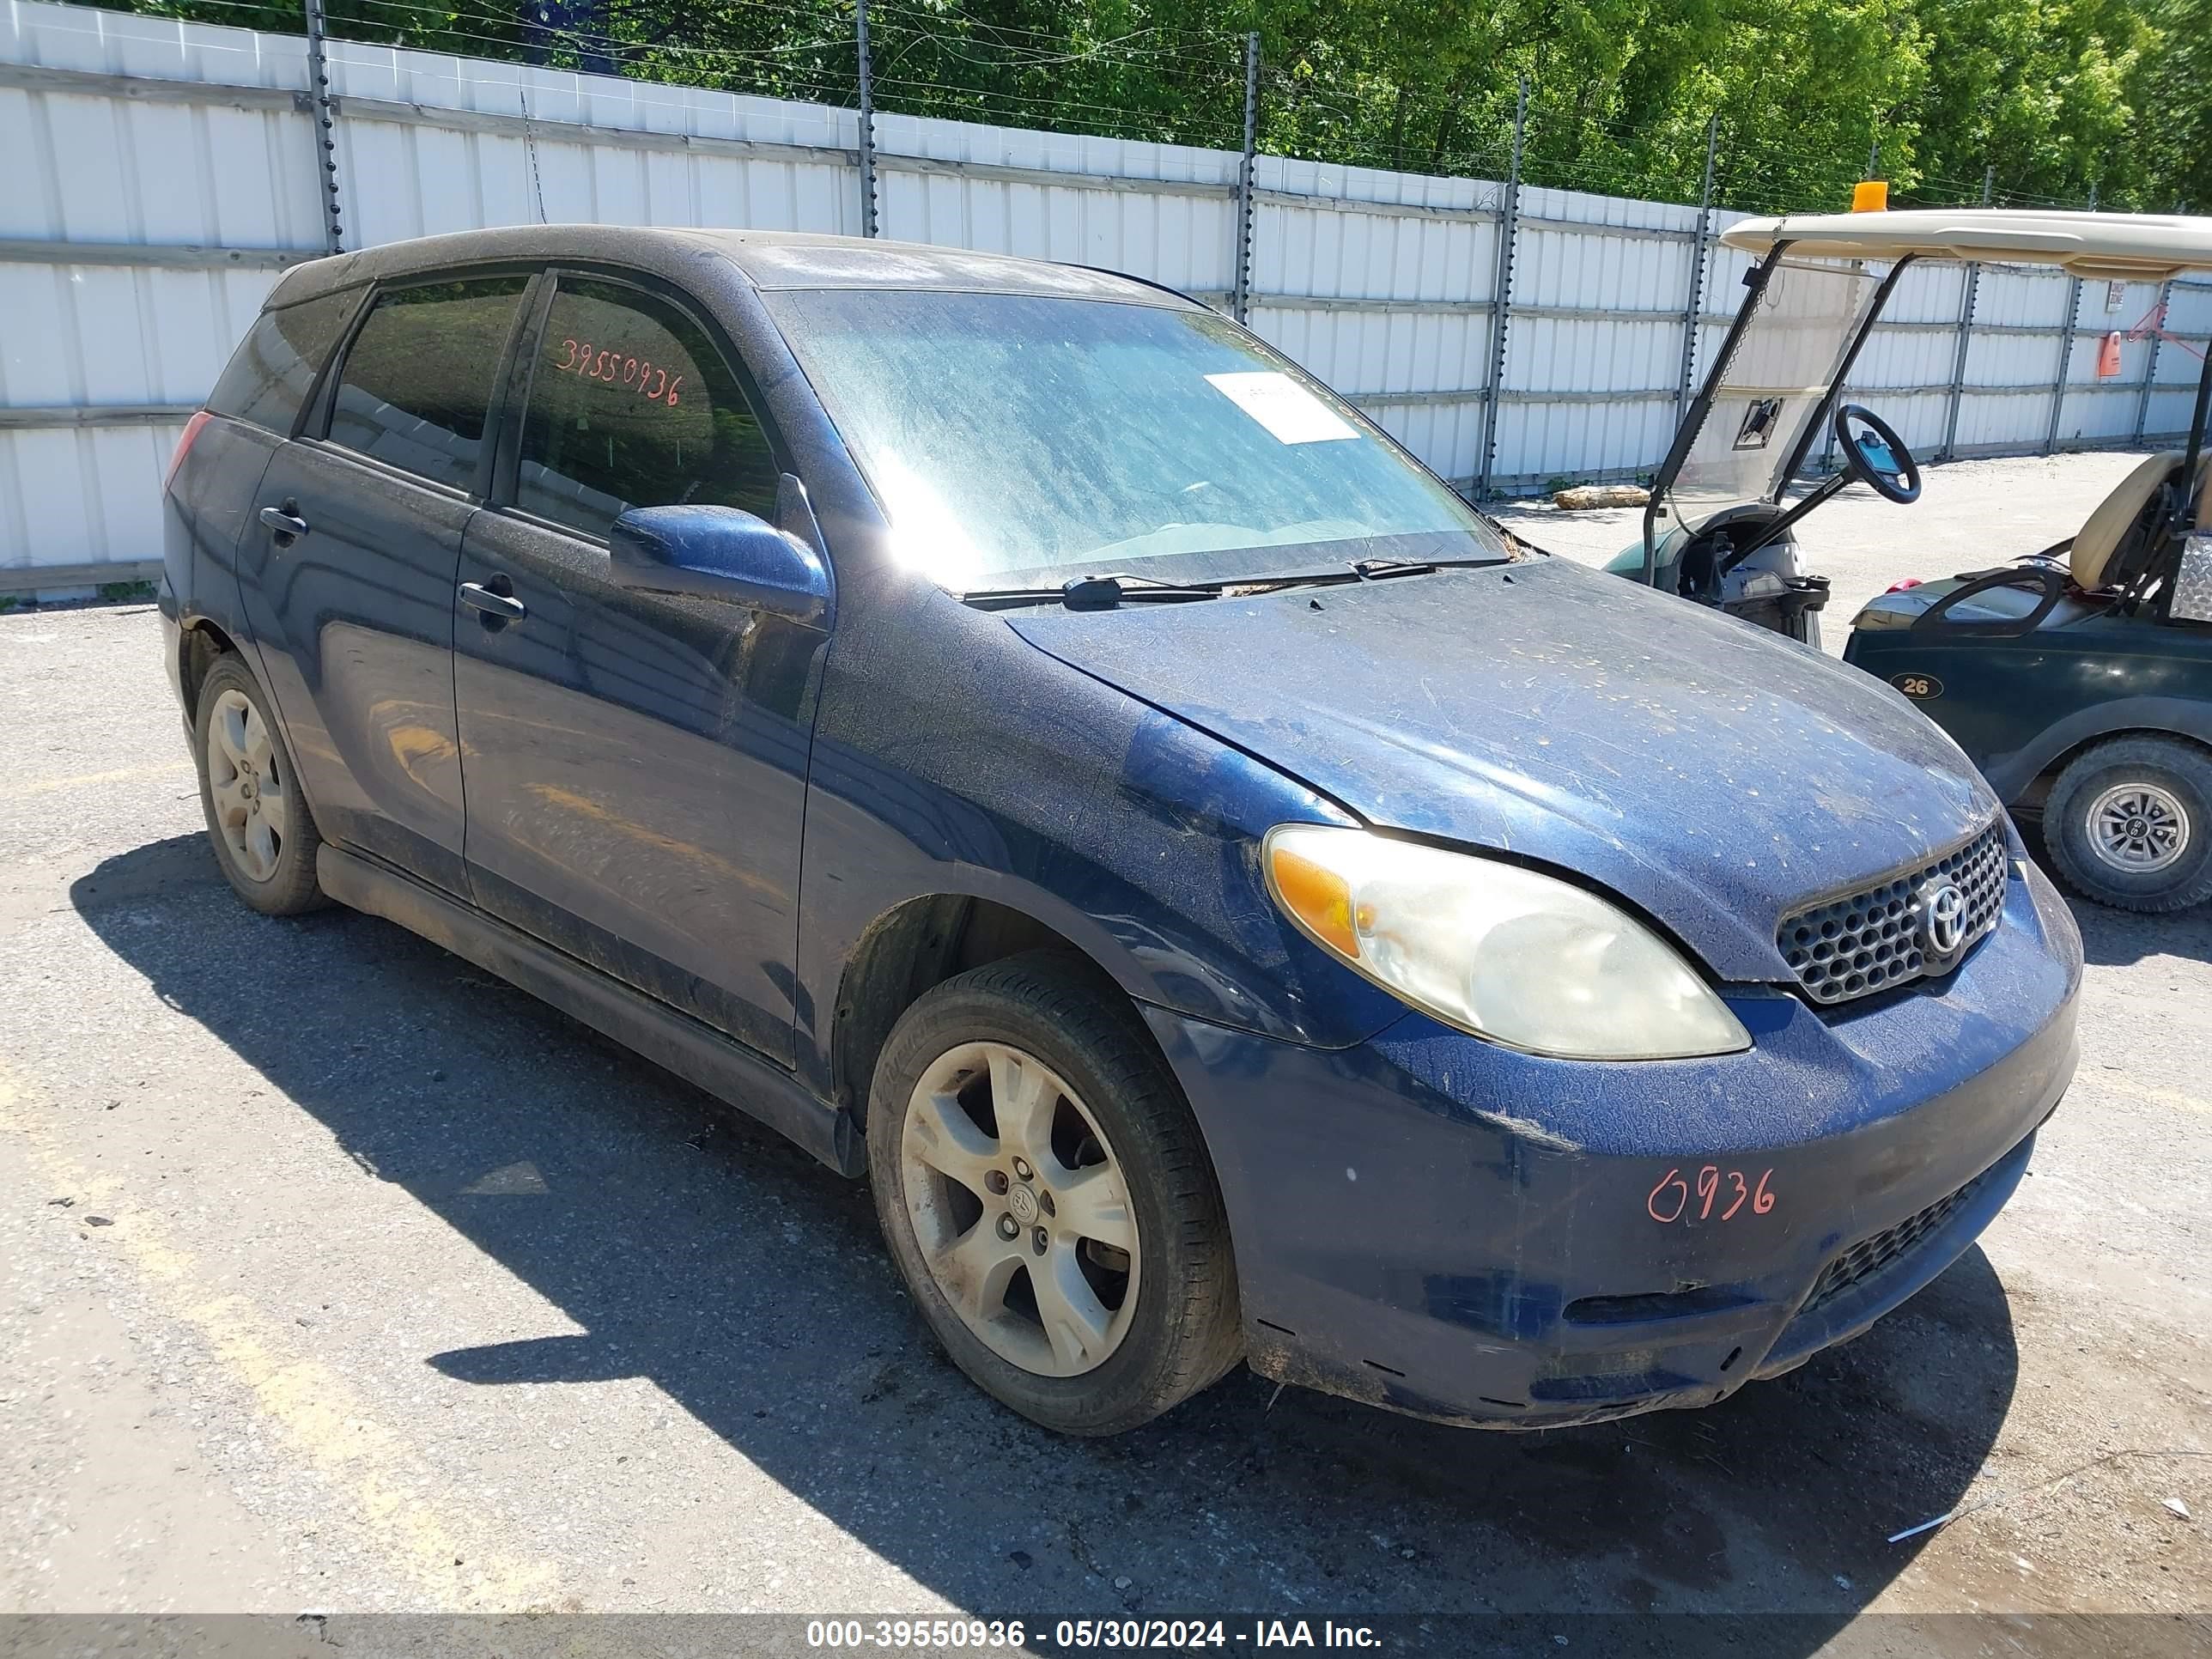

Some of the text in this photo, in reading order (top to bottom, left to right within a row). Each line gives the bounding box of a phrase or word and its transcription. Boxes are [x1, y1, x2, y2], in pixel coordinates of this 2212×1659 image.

[556, 339, 683, 406] 39550936
[1903, 678, 1929, 695] 26
[2130, 820, 2142, 836] SS
[1648, 1165, 1775, 1223] 0936
